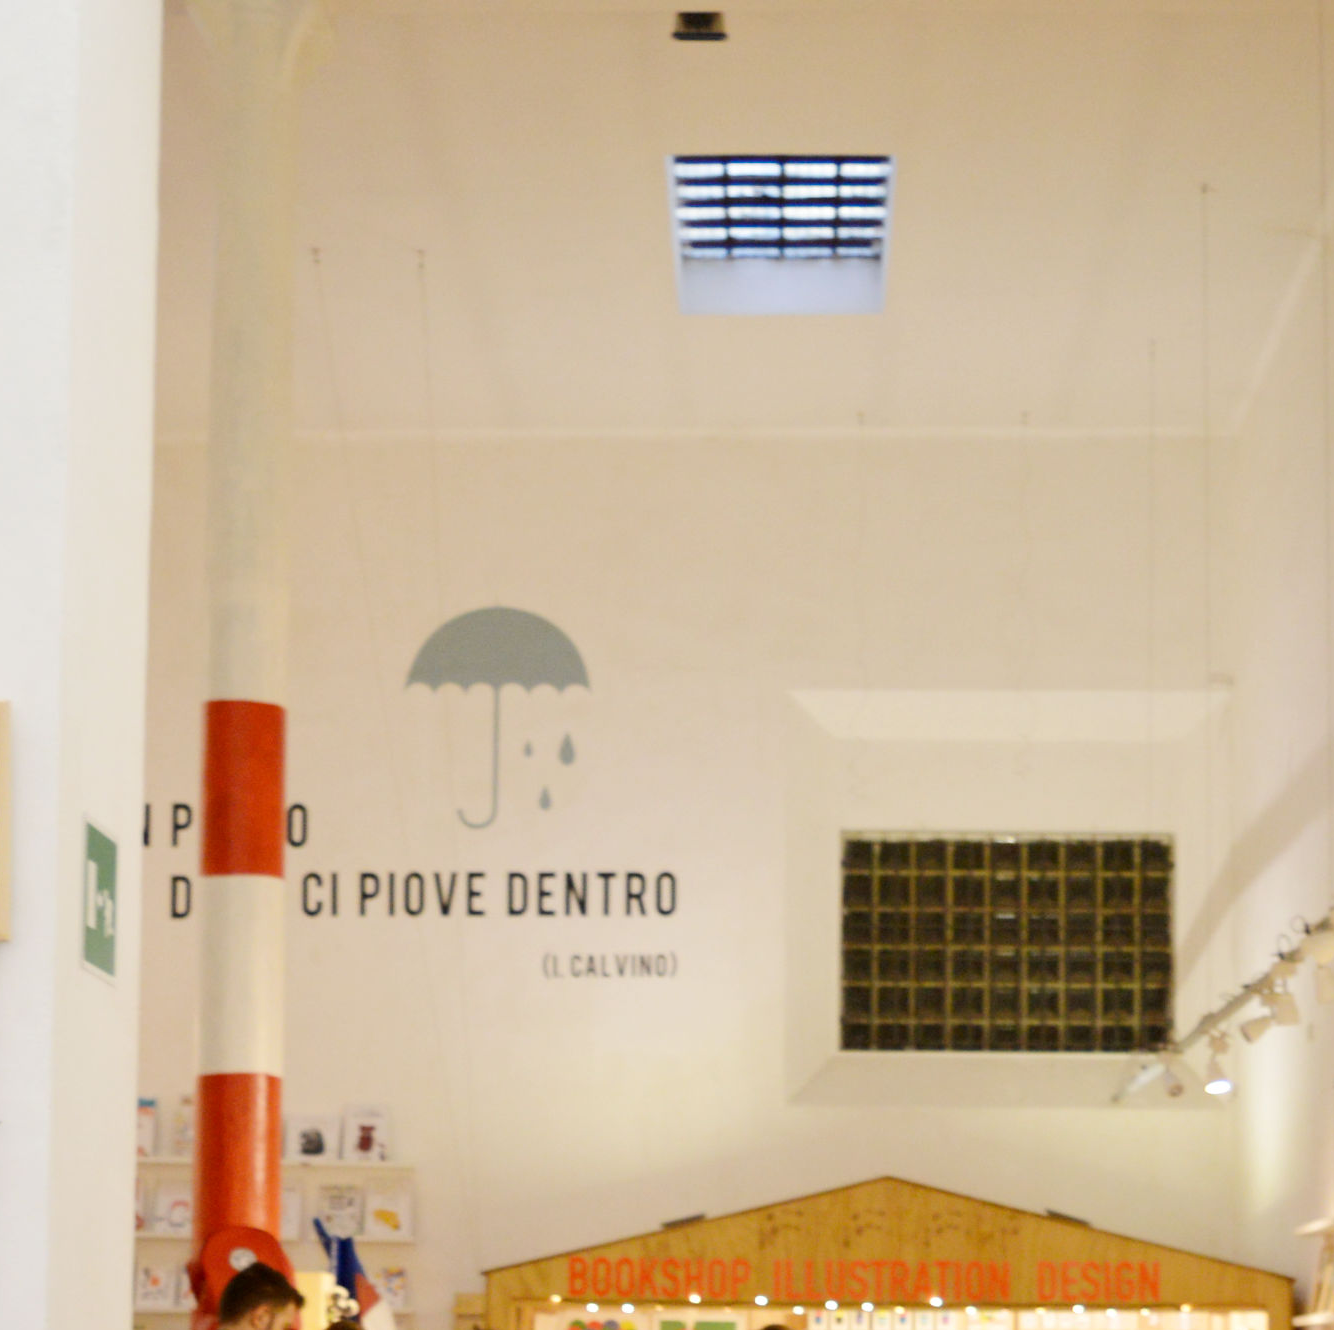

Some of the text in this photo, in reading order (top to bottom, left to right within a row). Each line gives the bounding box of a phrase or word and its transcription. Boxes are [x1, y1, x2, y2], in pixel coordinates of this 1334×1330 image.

[358, 872, 485, 917] PIOVE
[508, 872, 677, 917] DENTRO
[570, 951, 678, 979] CALVINO)
[568, 1256, 1160, 1302] BOOKSHOP ILLUSTRATION DESIGN
